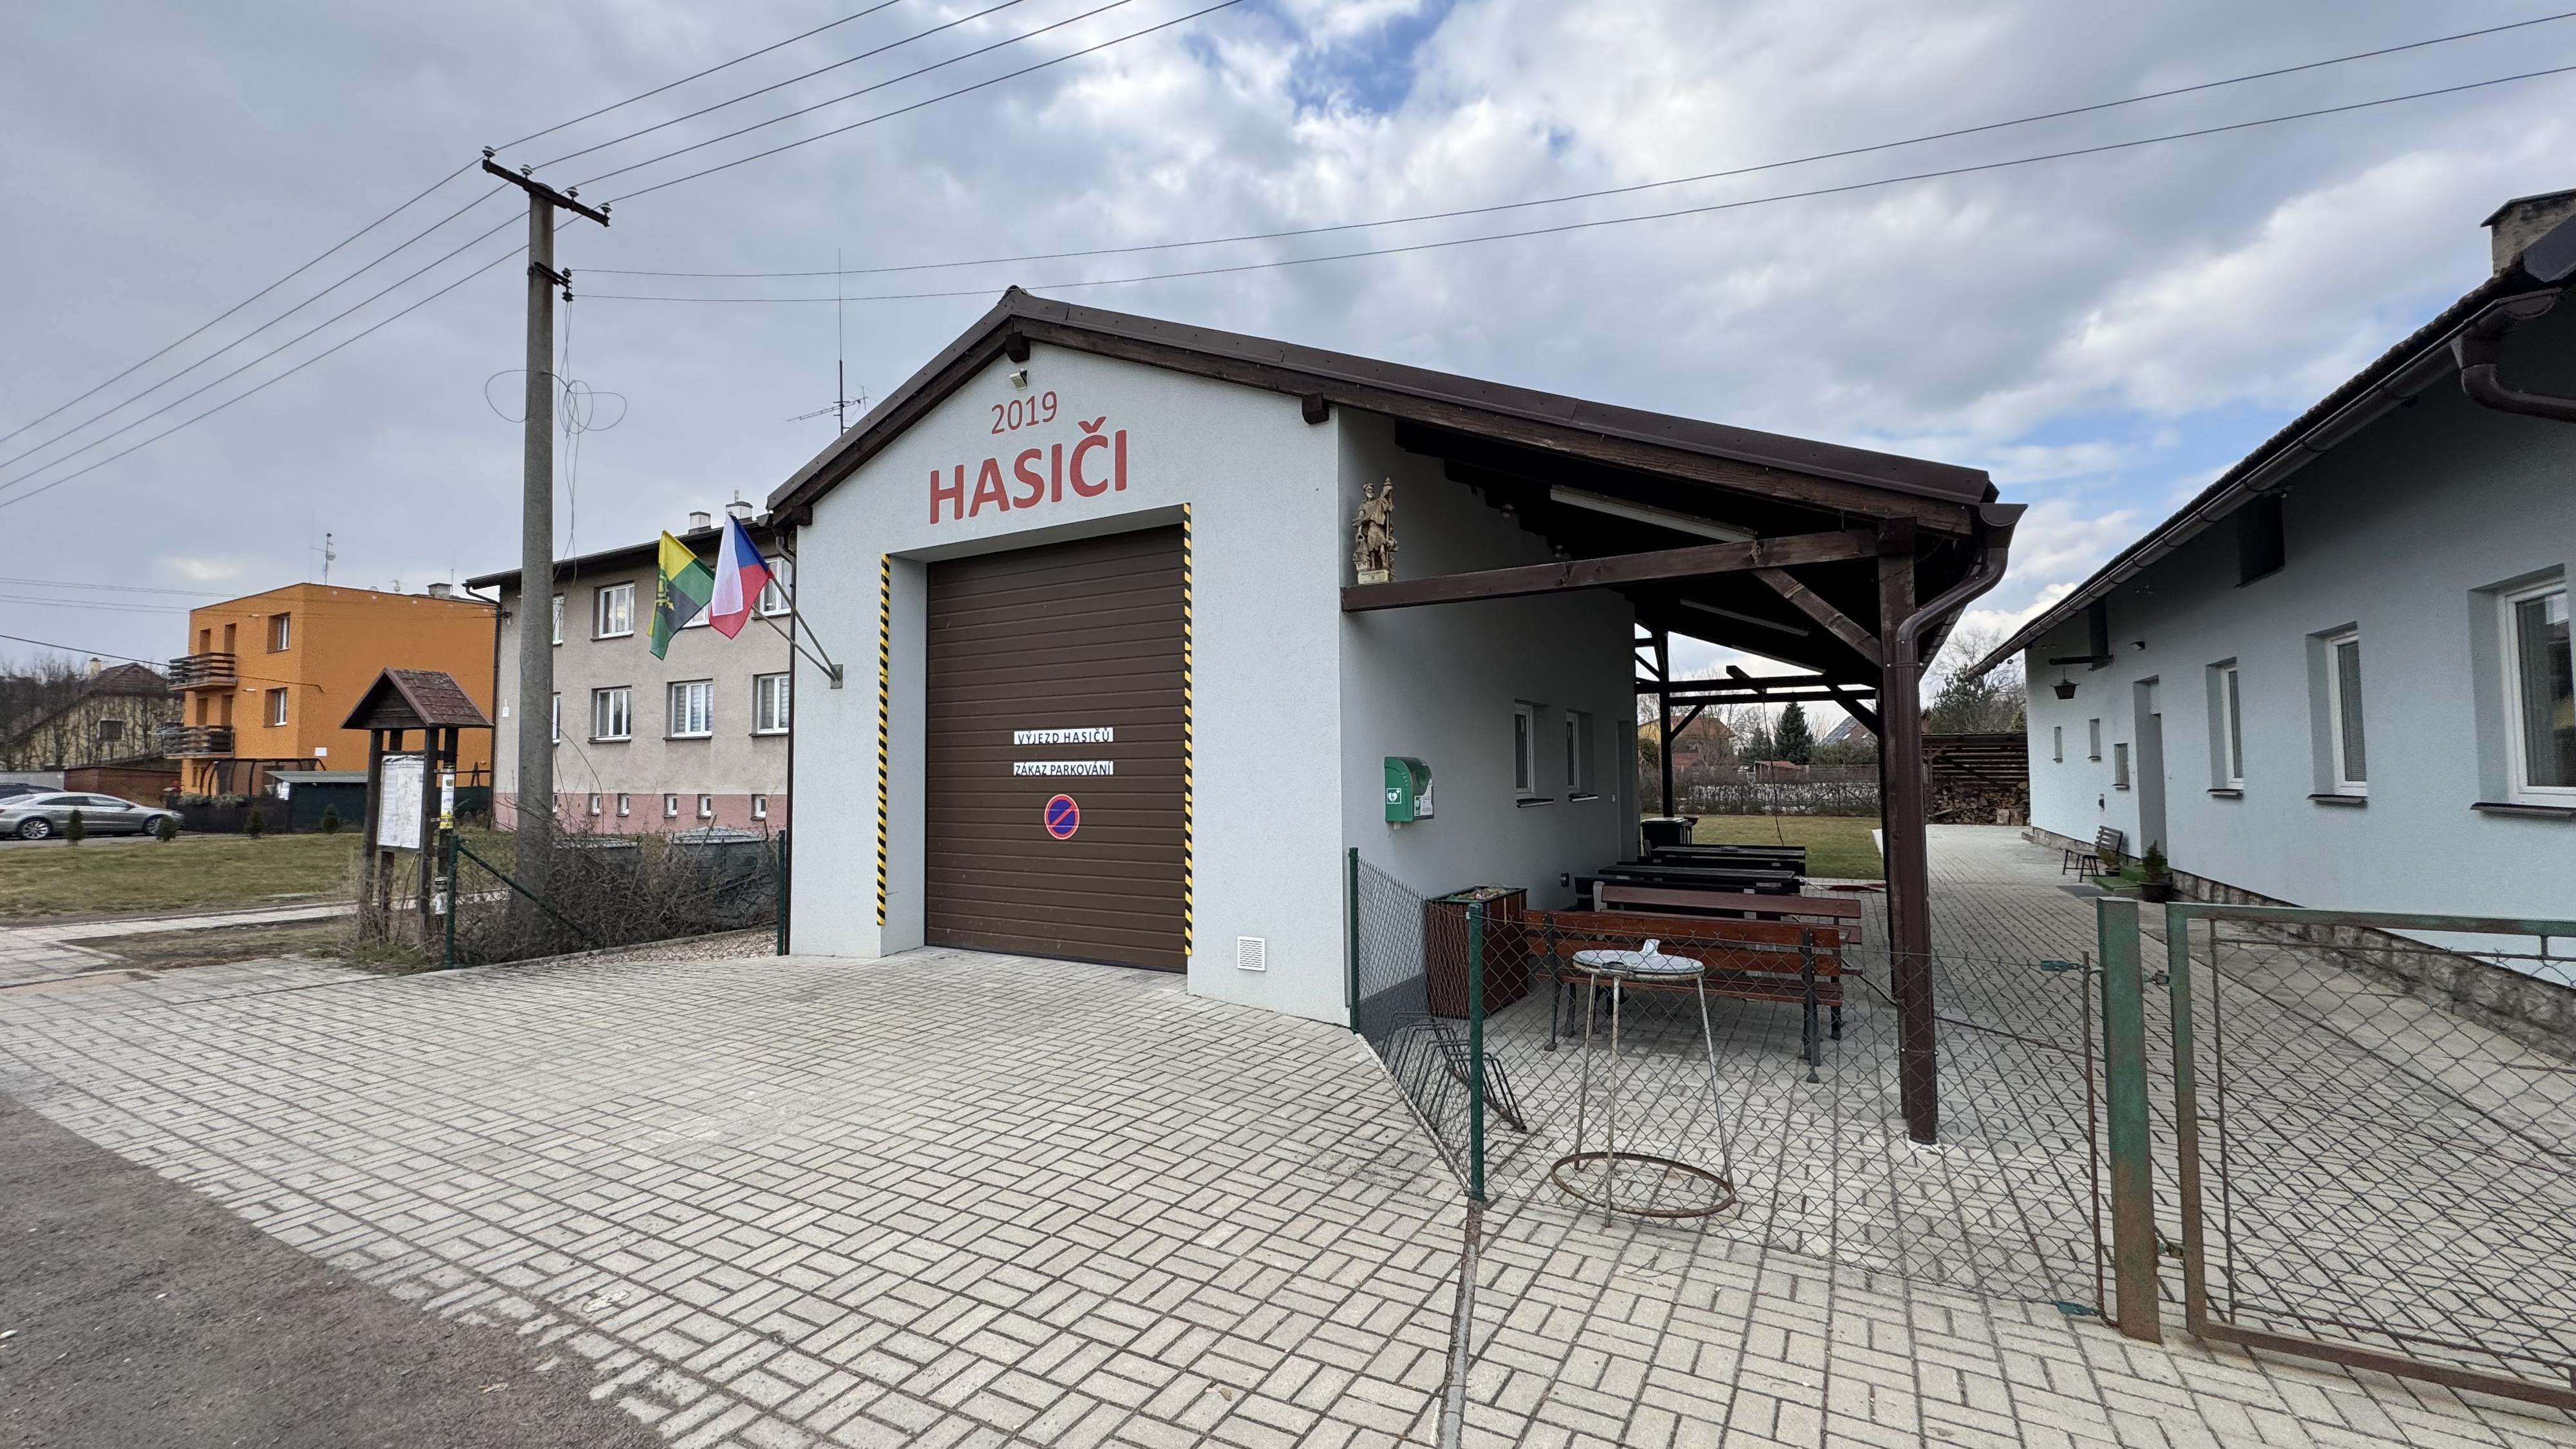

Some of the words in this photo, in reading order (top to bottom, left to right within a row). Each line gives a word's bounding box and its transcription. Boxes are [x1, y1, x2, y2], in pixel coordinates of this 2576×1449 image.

[991, 390, 1057, 434] 2019
[930, 416, 1127, 524] HASIČI
[1018, 731, 1059, 744] VÝJEZD
[1064, 728, 1109, 743] HASIČŮ
[1015, 762, 1047, 776] ZÁKAZ
[1050, 761, 1112, 776] PARKOVÁNÍ
